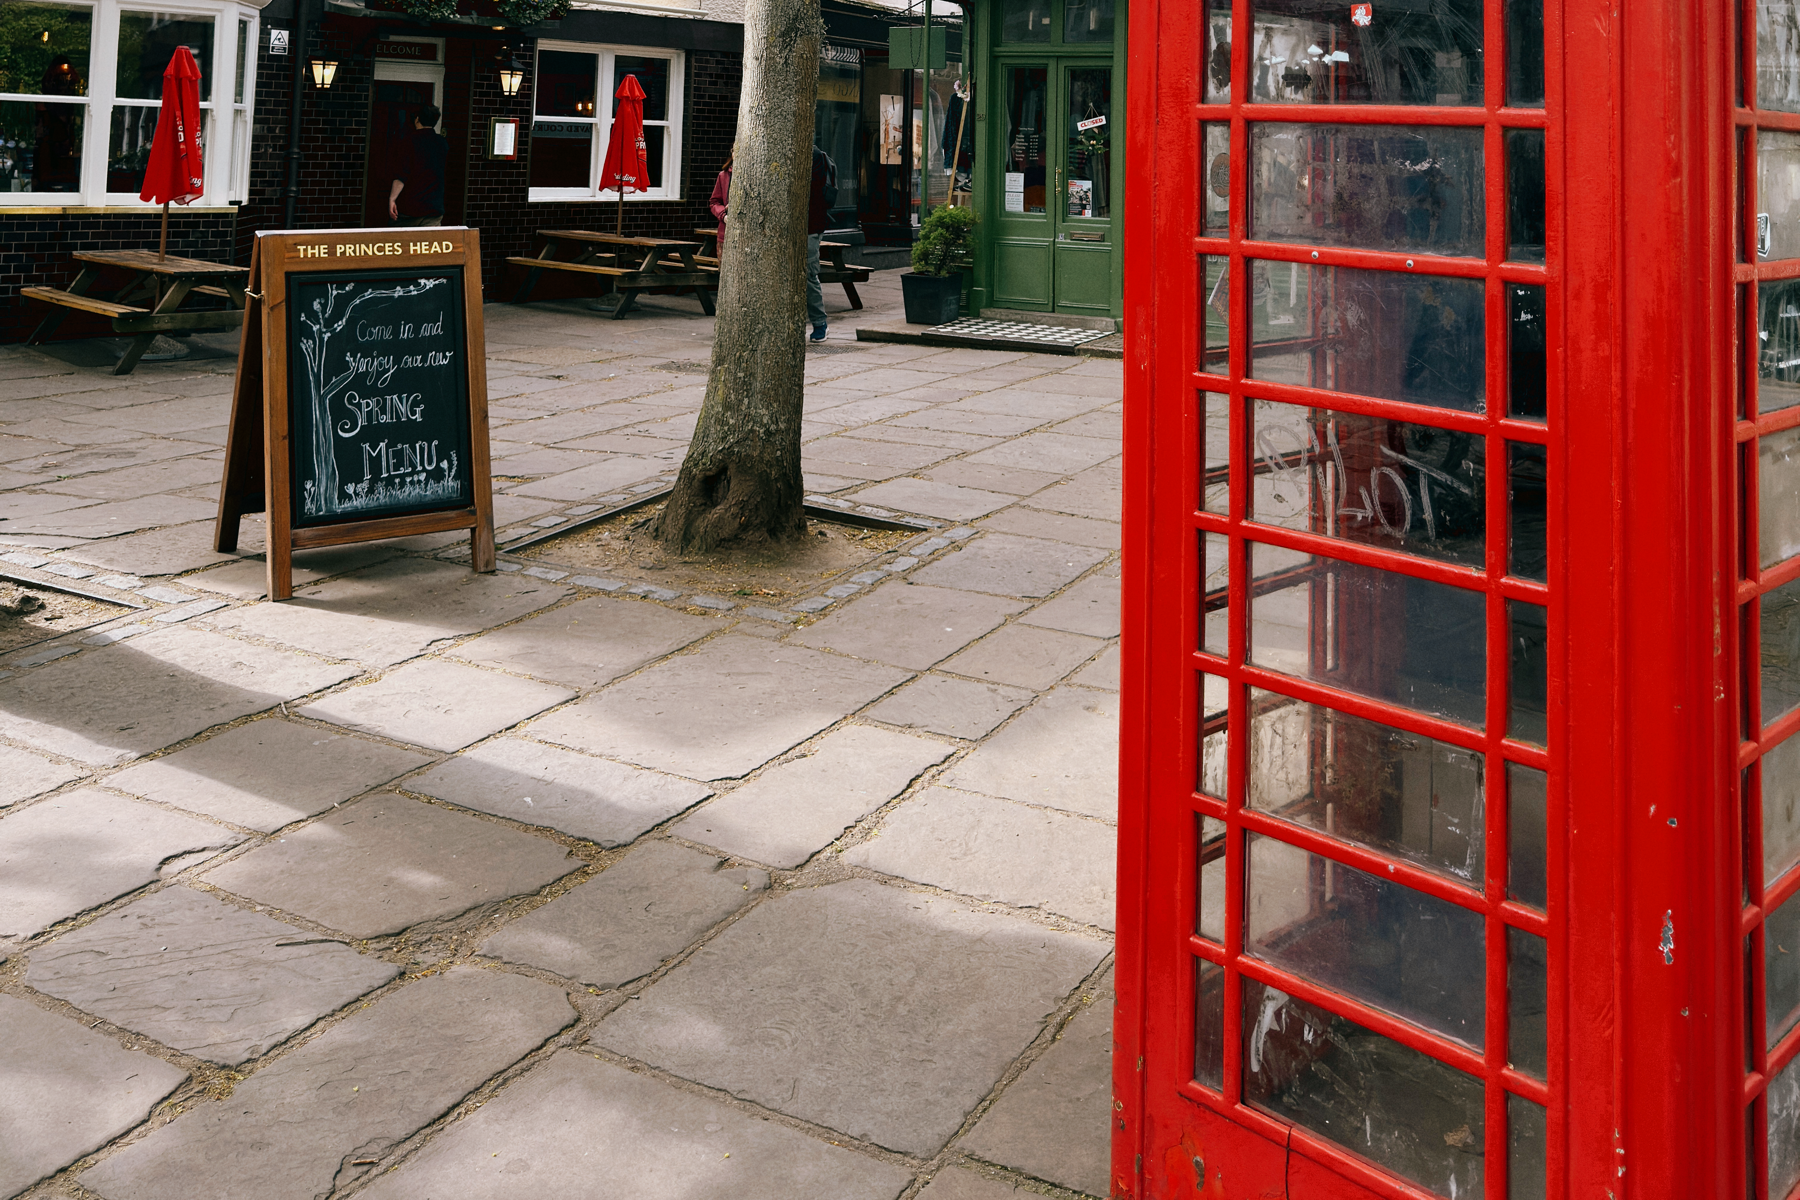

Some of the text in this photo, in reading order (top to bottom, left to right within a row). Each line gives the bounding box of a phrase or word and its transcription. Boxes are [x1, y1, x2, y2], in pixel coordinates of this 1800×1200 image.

[376, 43, 422, 56] ELCOME
[297, 241, 453, 258] THE PRINCES HEAD
[357, 311, 443, 341] Come in and
[358, 351, 453, 388] enjoy our new
[337, 390, 425, 438] SPRING
[361, 439, 438, 480] MENU
